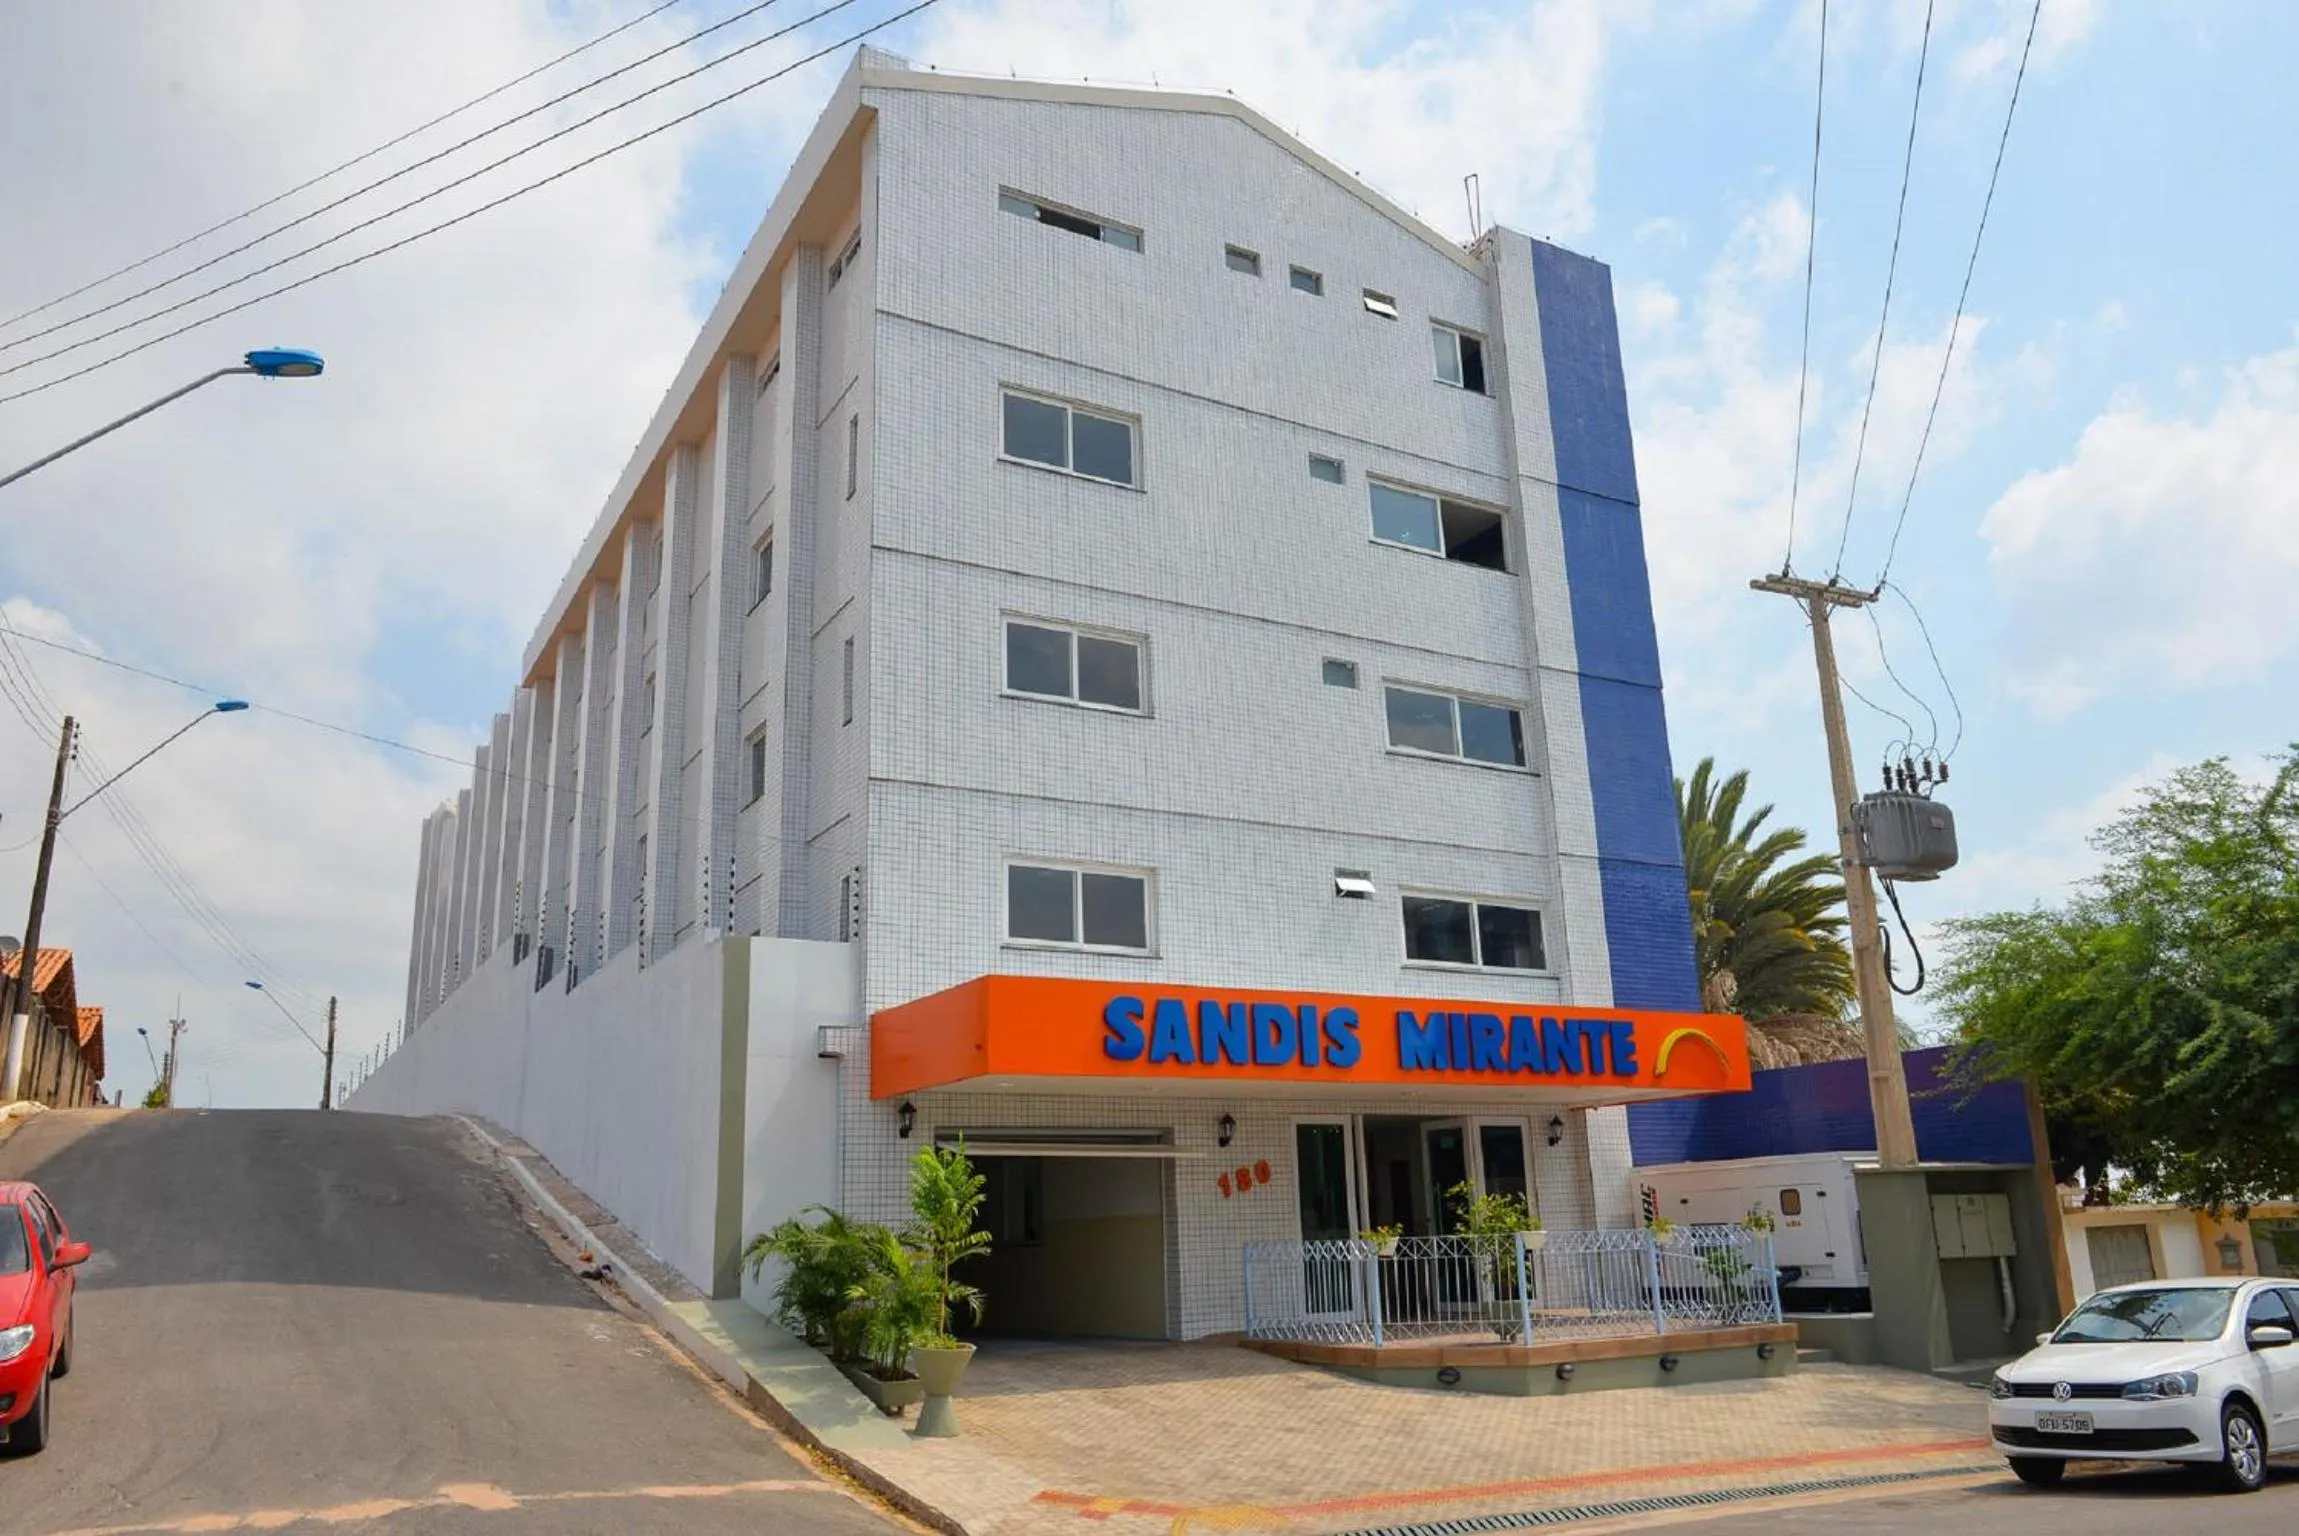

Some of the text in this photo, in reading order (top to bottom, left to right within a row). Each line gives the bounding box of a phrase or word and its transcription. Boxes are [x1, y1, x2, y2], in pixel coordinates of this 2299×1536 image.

[1103, 995, 1639, 1077] SANDIS MIRANTE
[1217, 1159, 1272, 1198] 180
